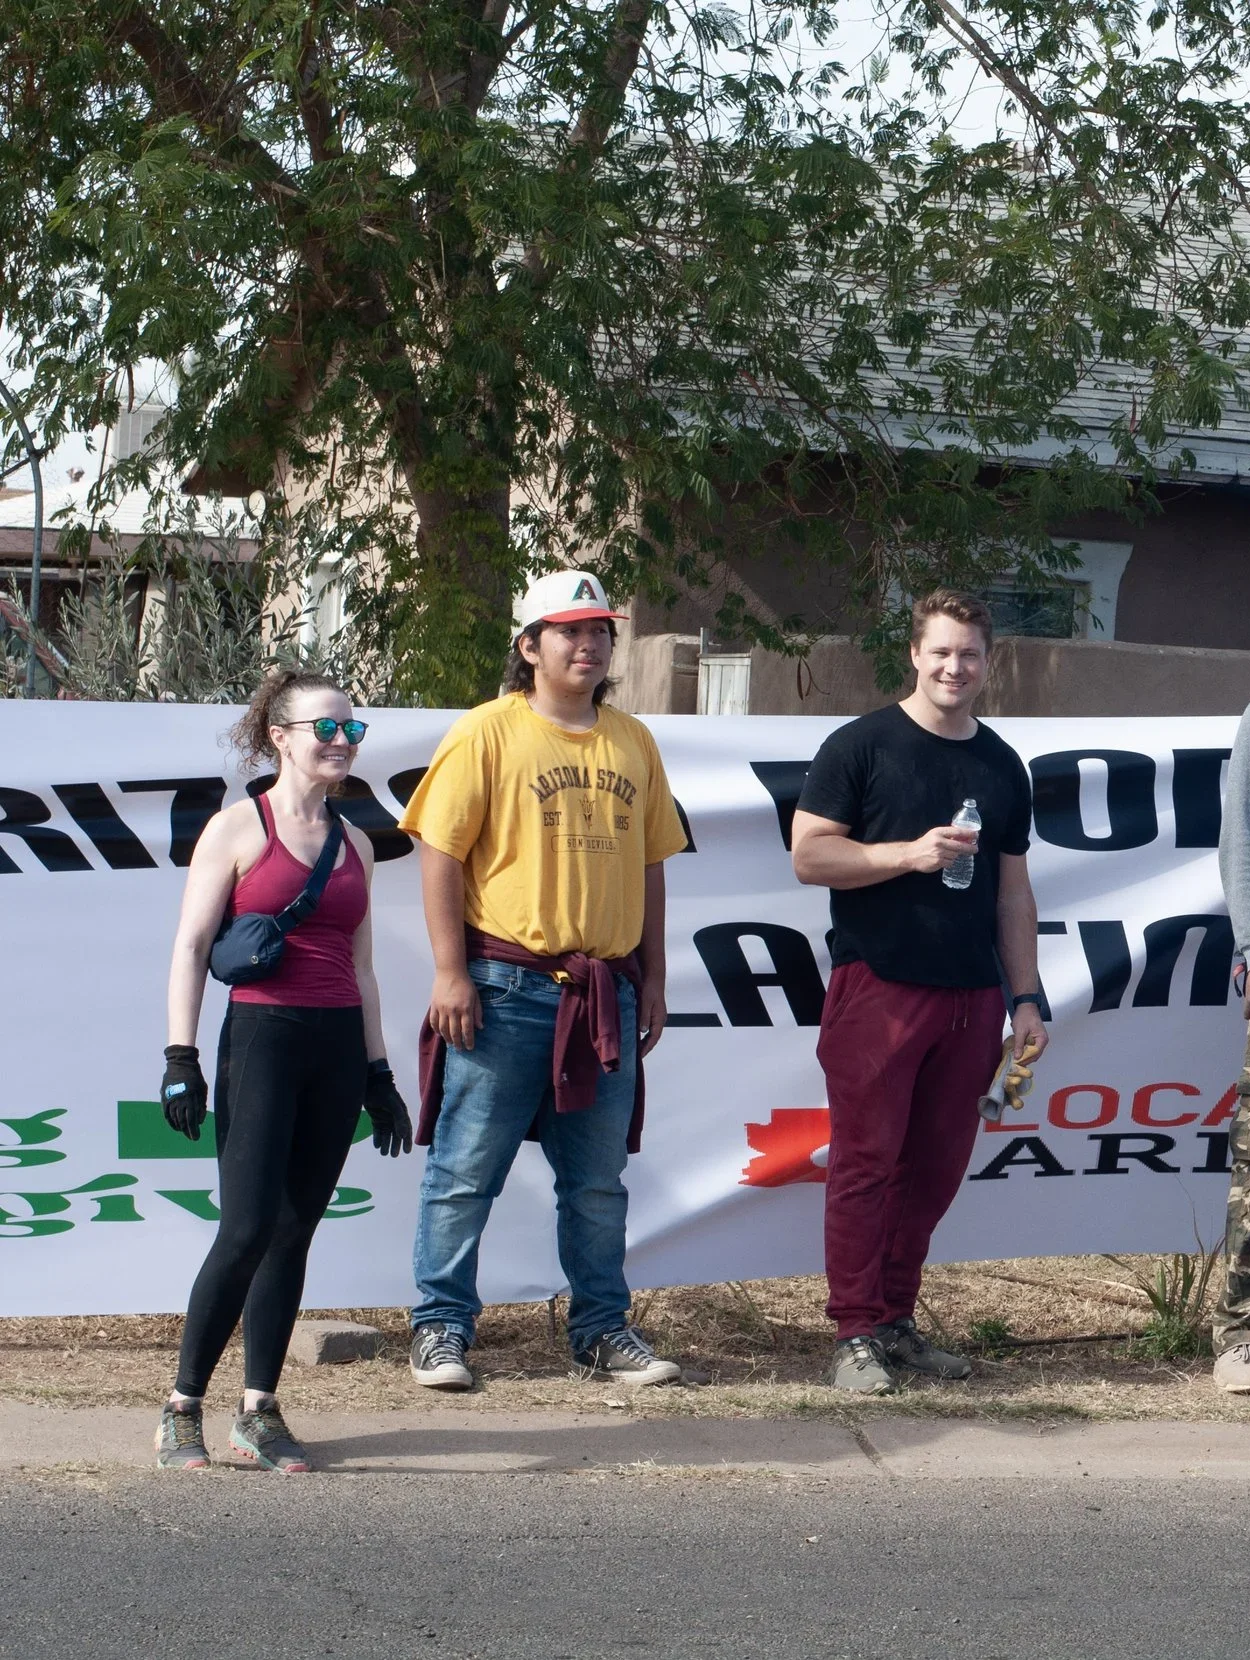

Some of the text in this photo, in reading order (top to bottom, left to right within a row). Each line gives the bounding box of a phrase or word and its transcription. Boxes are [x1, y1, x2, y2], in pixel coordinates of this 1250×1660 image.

[572, 579, 598, 601] A
[529, 766, 592, 803] ARIZONA
[567, 838, 583, 848] SUN
